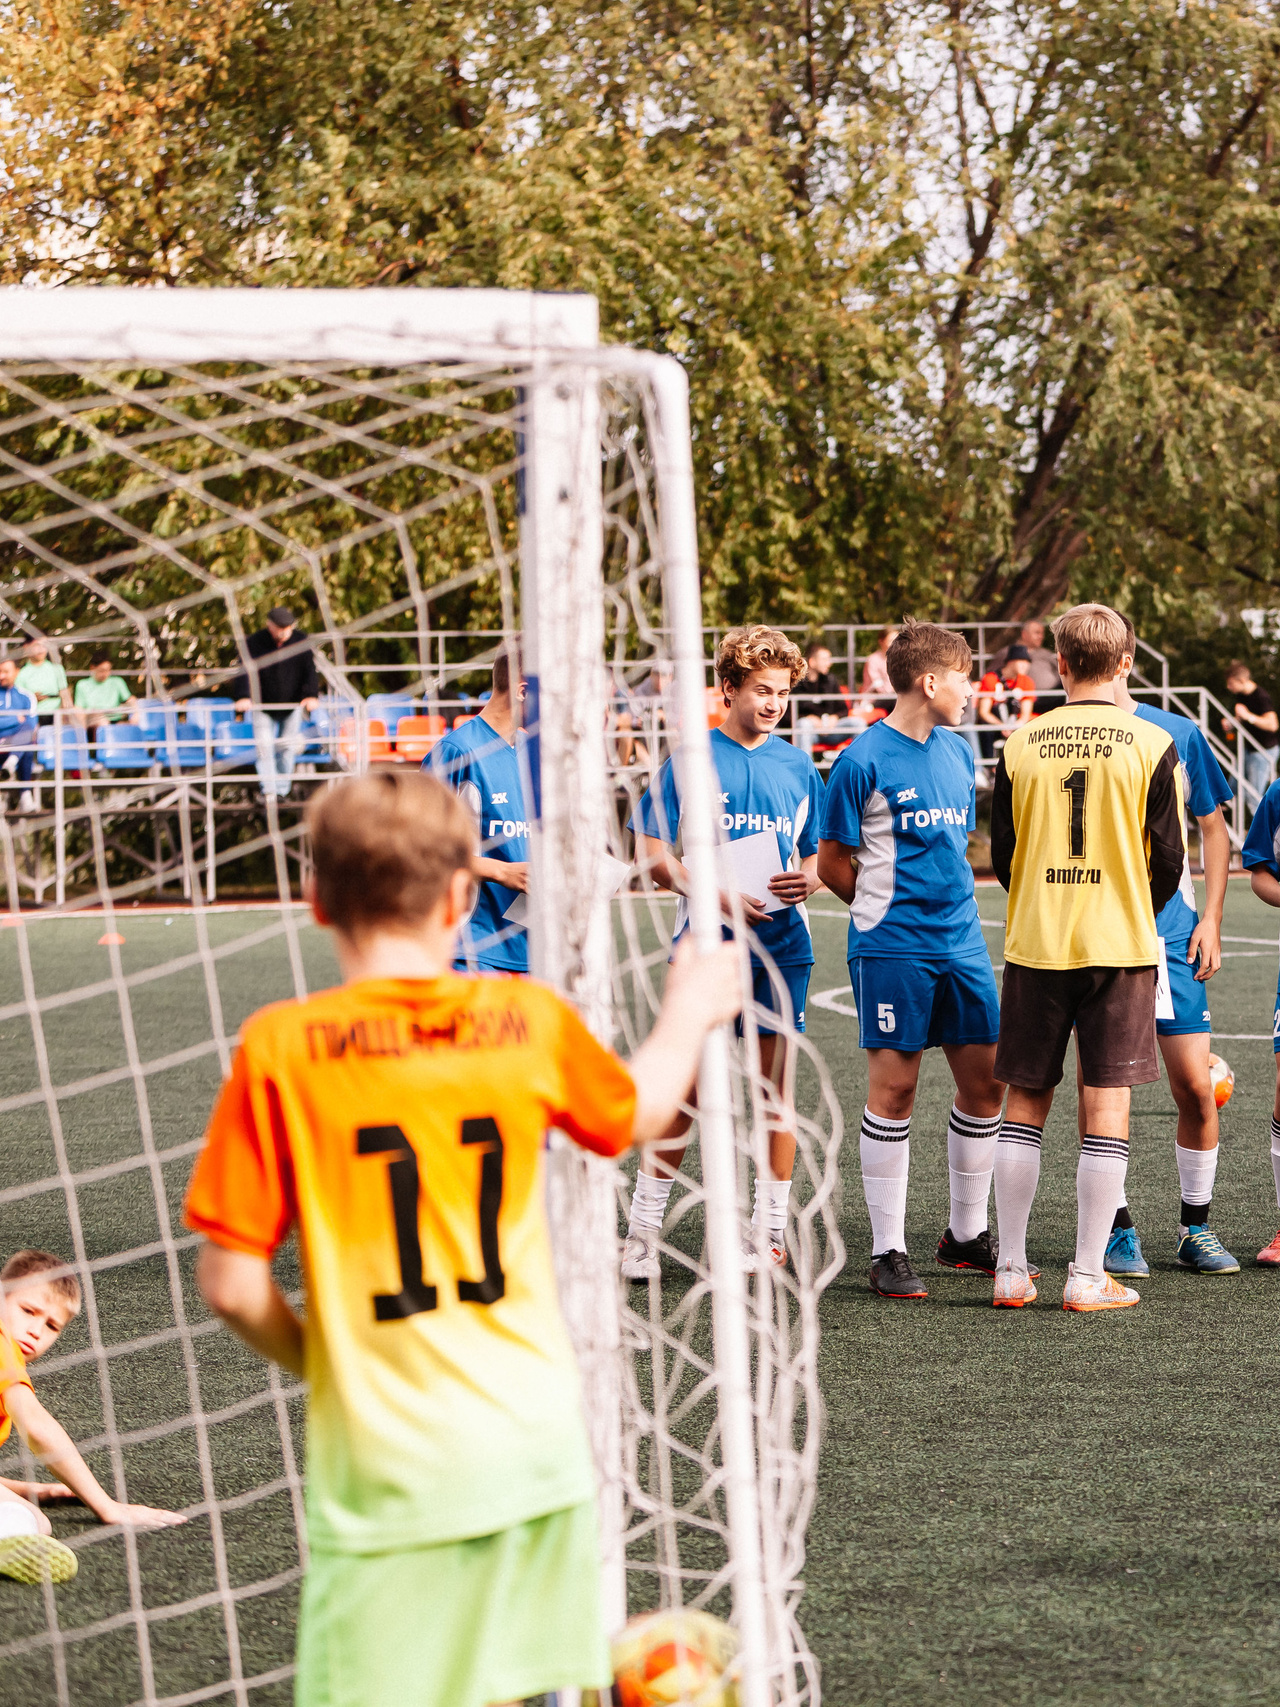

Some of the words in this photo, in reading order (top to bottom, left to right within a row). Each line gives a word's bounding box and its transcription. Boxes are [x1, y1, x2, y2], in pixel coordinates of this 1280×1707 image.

[1028, 726, 1133, 745] МИНИСТЕРСТВО
[1040, 743, 1090, 758] СПОРТА
[1095, 744, 1112, 758] РФ
[1061, 767, 1088, 859] 1
[489, 820, 532, 838] ГОРН
[720, 813, 792, 837] ОРНЫЙ
[1046, 867, 1101, 884] amfr.ru
[878, 1003, 896, 1032] 5
[355, 1117, 506, 1322] 11
